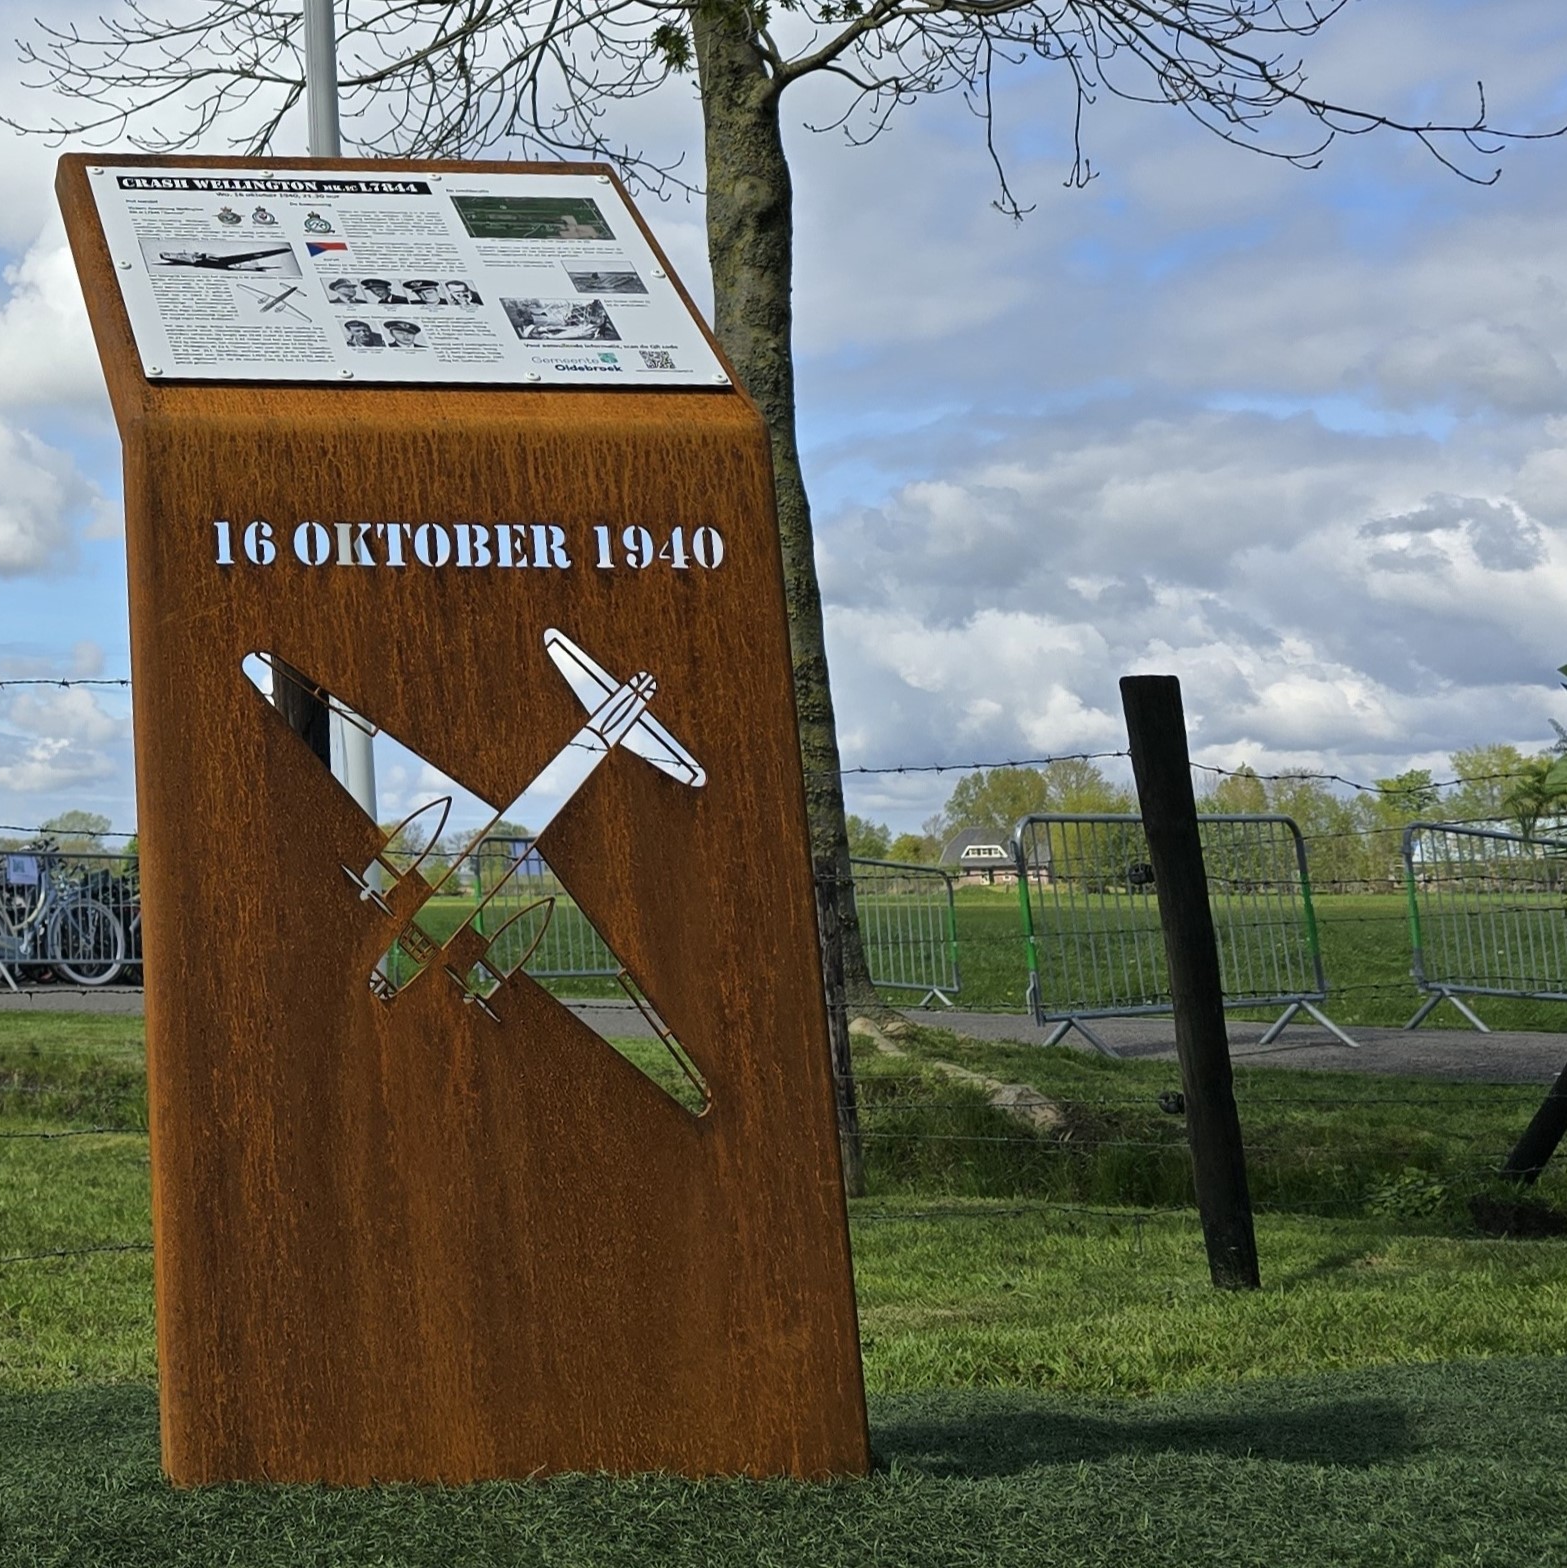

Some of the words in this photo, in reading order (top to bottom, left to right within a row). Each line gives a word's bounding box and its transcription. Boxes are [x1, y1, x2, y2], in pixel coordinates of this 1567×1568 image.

[122, 178, 189, 188] CRASH
[192, 179, 318, 191] WELLINGTON
[359, 182, 418, 193] L7844
[531, 355, 599, 364] Gemeente
[555, 364, 623, 372] Oldebroek
[213, 521, 276, 565] 16
[293, 521, 572, 569] OKTOBER
[593, 525, 724, 570] 1940
